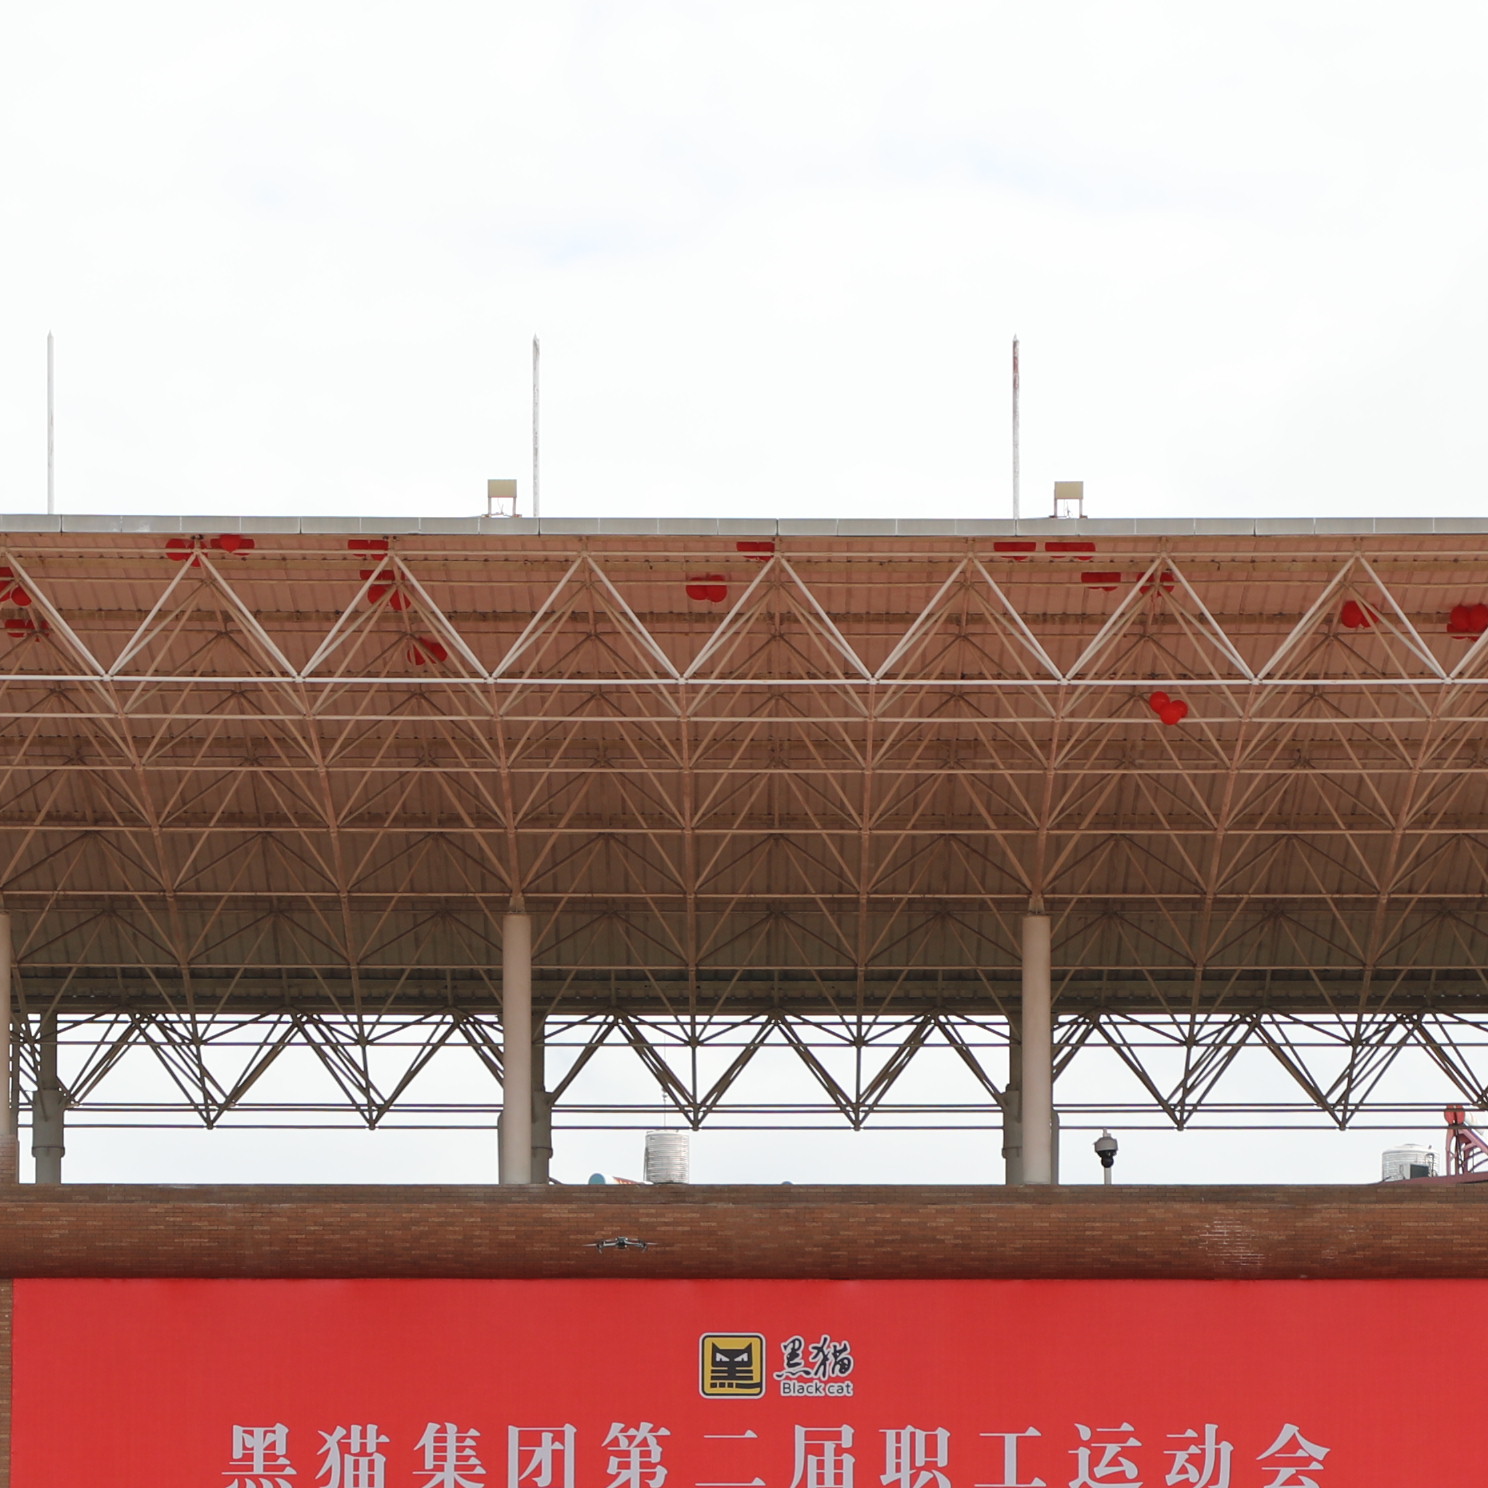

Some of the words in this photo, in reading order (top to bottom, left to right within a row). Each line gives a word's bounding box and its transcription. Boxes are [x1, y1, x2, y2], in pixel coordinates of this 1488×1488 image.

[775, 1335, 853, 1380] 黑猫
[781, 1382, 822, 1395] Black
[827, 1382, 852, 1395] cat
